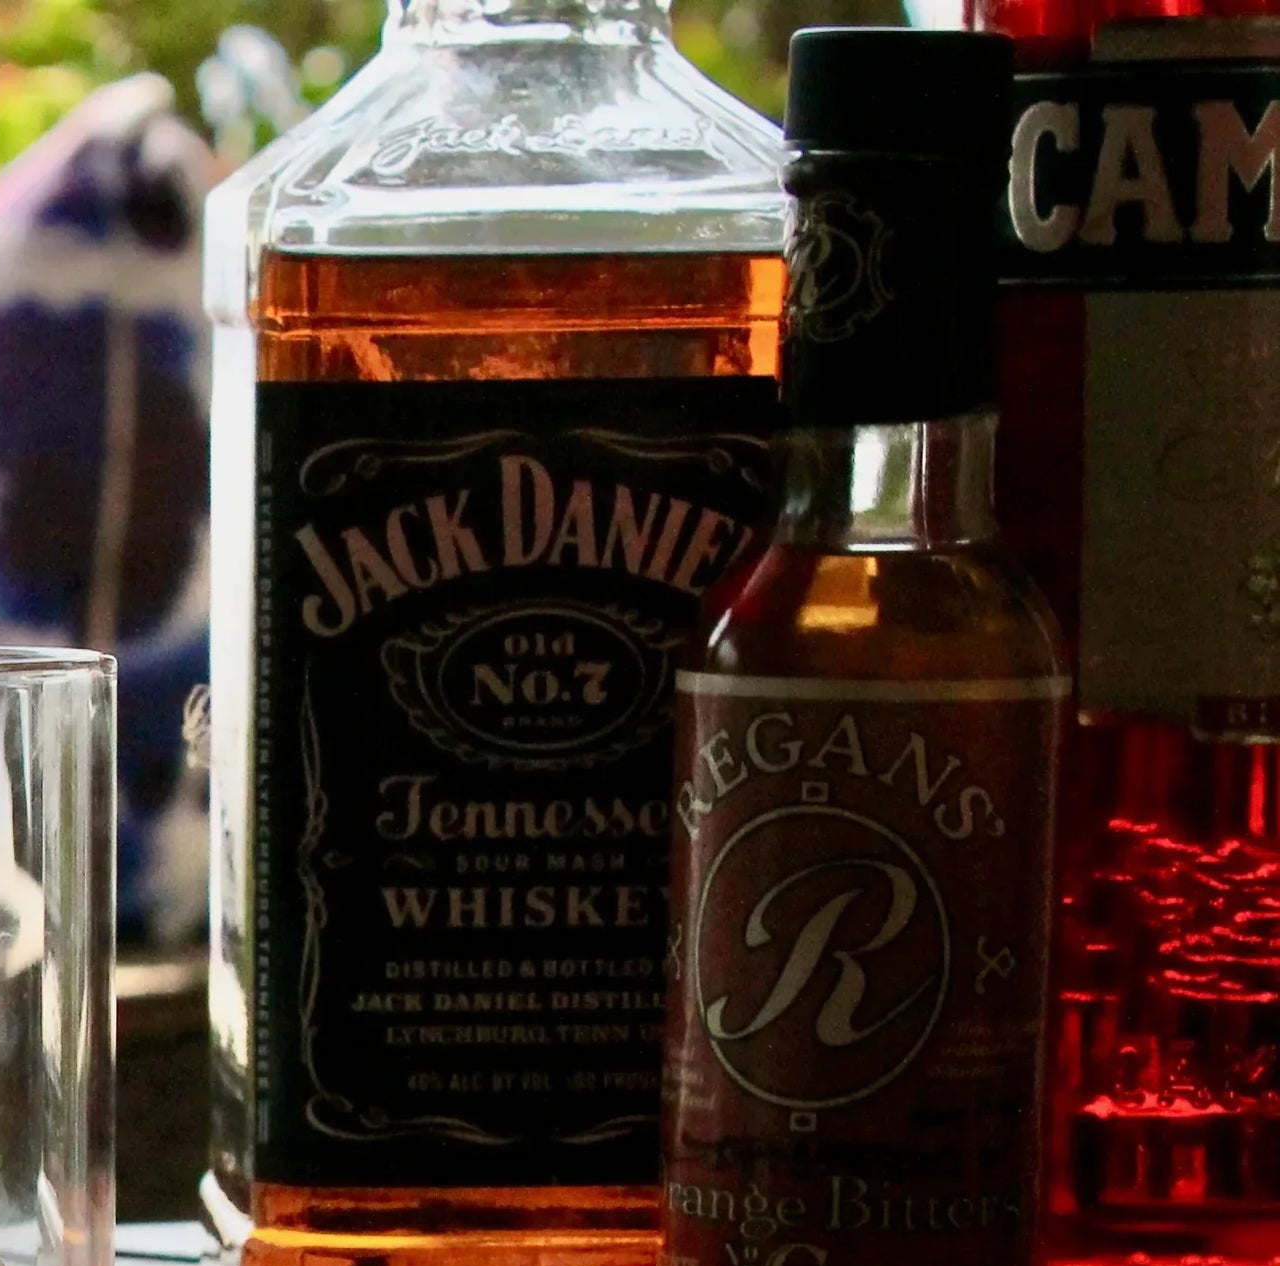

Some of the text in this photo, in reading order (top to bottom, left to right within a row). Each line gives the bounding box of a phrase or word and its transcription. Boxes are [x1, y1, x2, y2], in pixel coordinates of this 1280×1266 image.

[1008, 98, 1280, 252] CAM
[295, 489, 494, 638] JACK
[502, 631, 577, 657] Old
[455, 852, 531, 875] SOUR
[385, 958, 513, 979] DISTILLED
[706, 858, 938, 1047] R
[350, 991, 423, 1012] JACK
[433, 991, 542, 1012] DANIEL
[669, 1175, 1021, 1240] range Bitters
